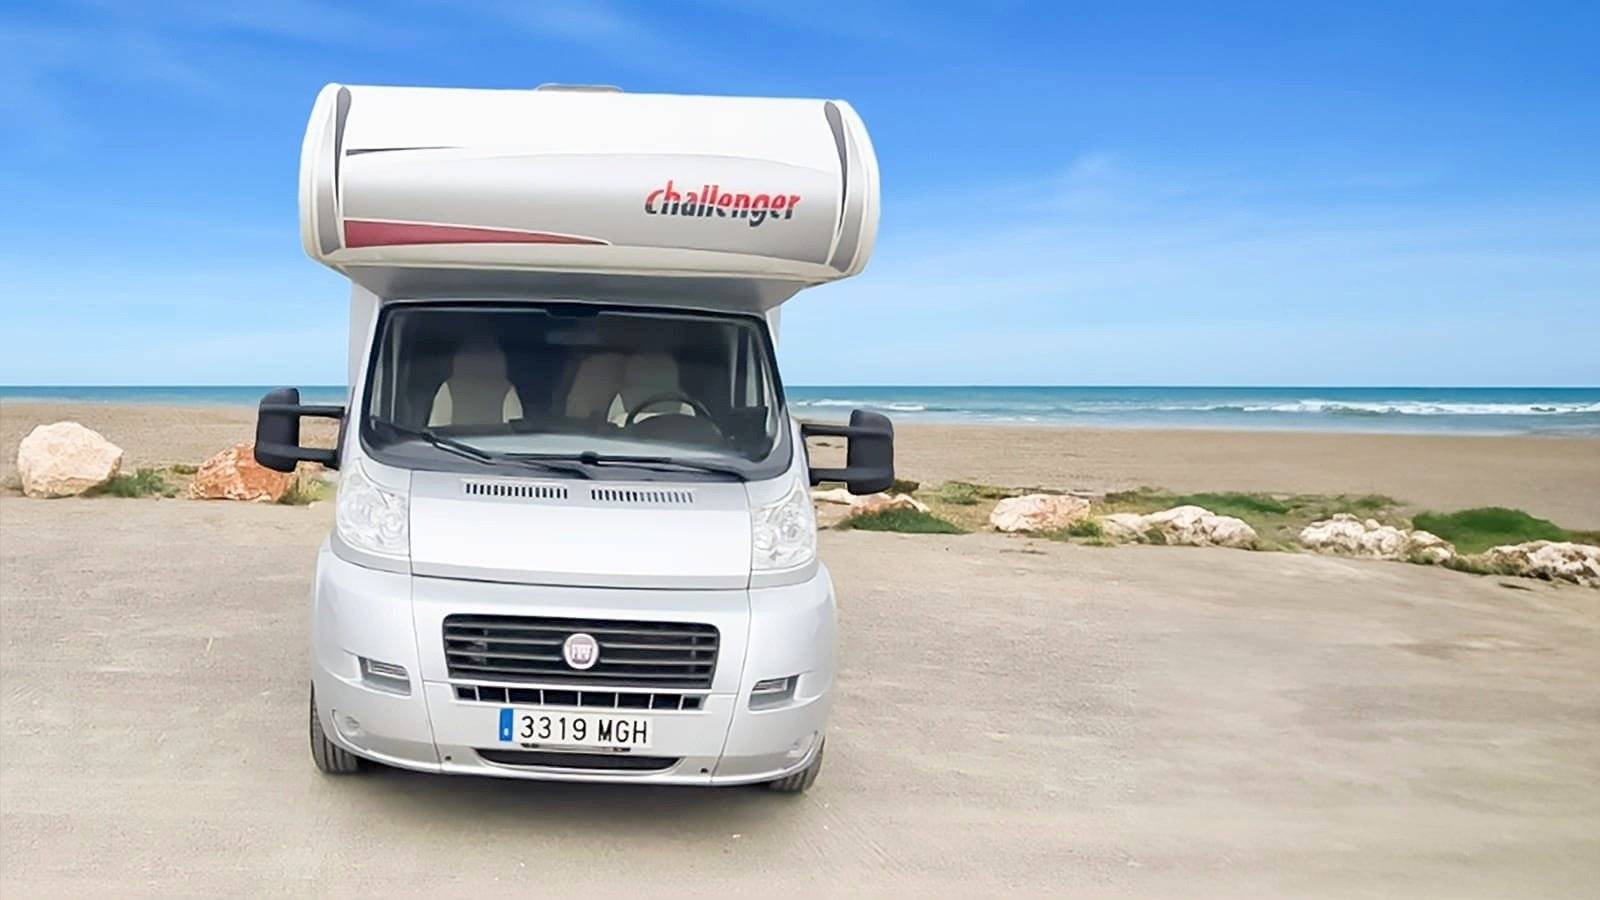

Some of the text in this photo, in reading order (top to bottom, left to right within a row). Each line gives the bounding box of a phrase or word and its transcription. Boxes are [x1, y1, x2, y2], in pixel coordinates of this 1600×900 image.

[644, 180, 801, 227] challenger
[520, 715, 648, 744] 3319 MGH
